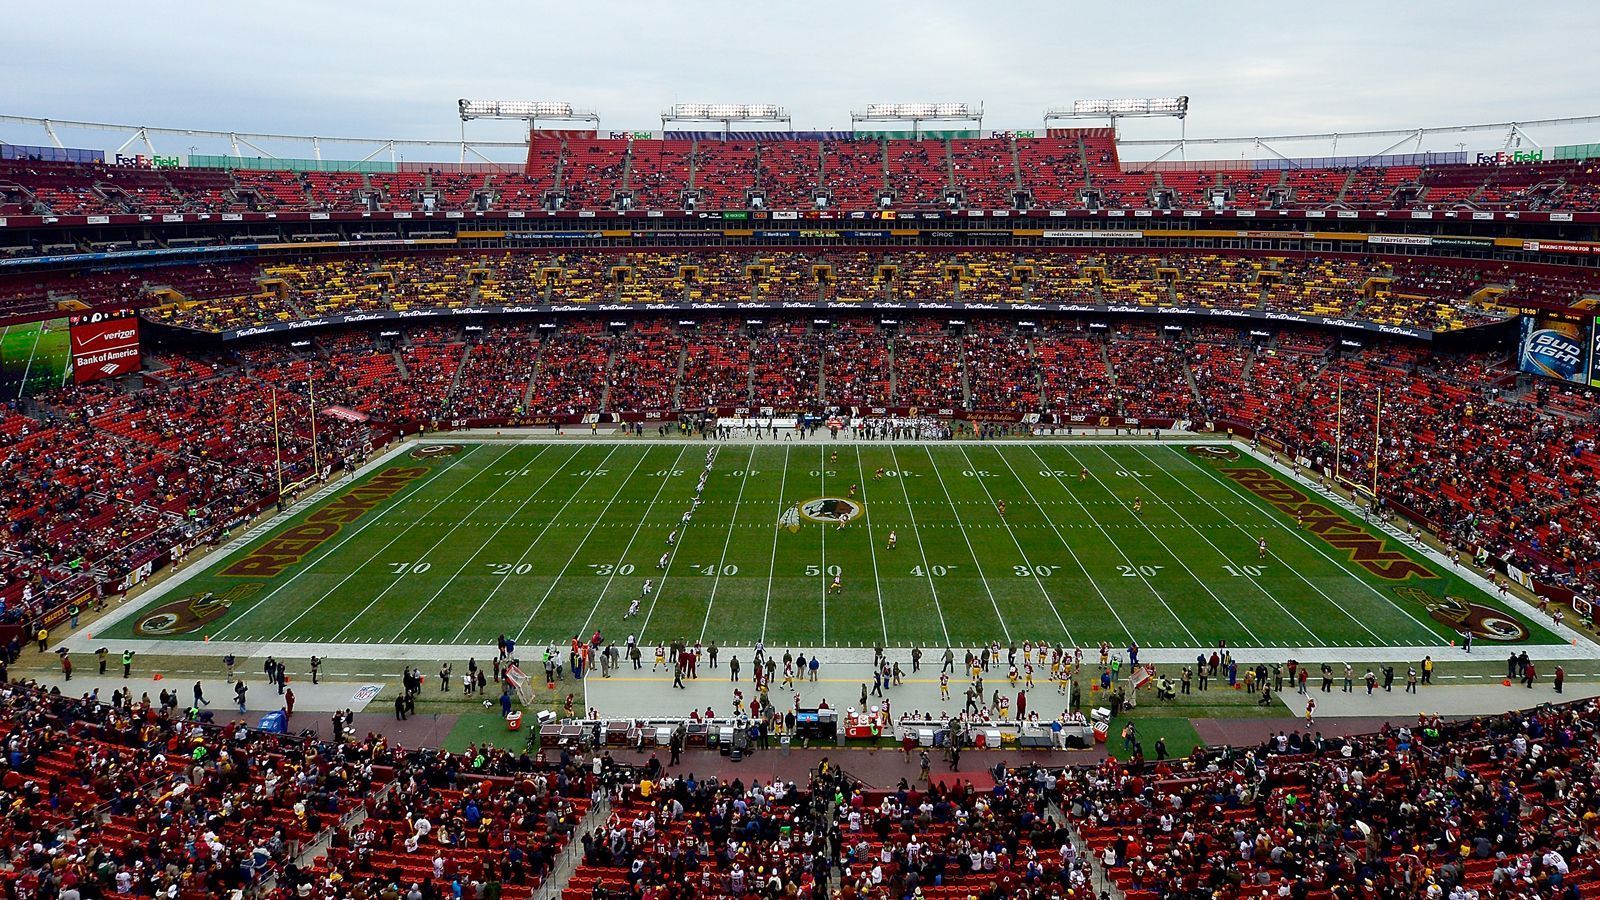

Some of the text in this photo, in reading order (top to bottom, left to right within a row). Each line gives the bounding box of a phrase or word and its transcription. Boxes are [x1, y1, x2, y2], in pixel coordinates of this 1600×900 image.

[115, 154, 179, 166] FedExField
[1477, 150, 1543, 164] FedExField
[104, 329, 135, 340] verizon
[1536, 335, 1580, 355] BUD
[77, 355, 98, 366] Bank
[108, 349, 138, 360] America
[1528, 343, 1580, 365] LIGHT
[215, 466, 432, 578] REDSKINS
[1220, 468, 1441, 580] REDSKINS
[392, 562, 431, 574] 10
[491, 563, 533, 575] 20
[596, 564, 635, 575] 30
[701, 565, 738, 576] 40
[805, 565, 842, 576] 50
[910, 565, 947, 576] 40
[1013, 565, 1052, 577] 30
[1116, 565, 1157, 577] 20
[1221, 565, 1262, 577] 10
[1551, 854, 1561, 863] 10
